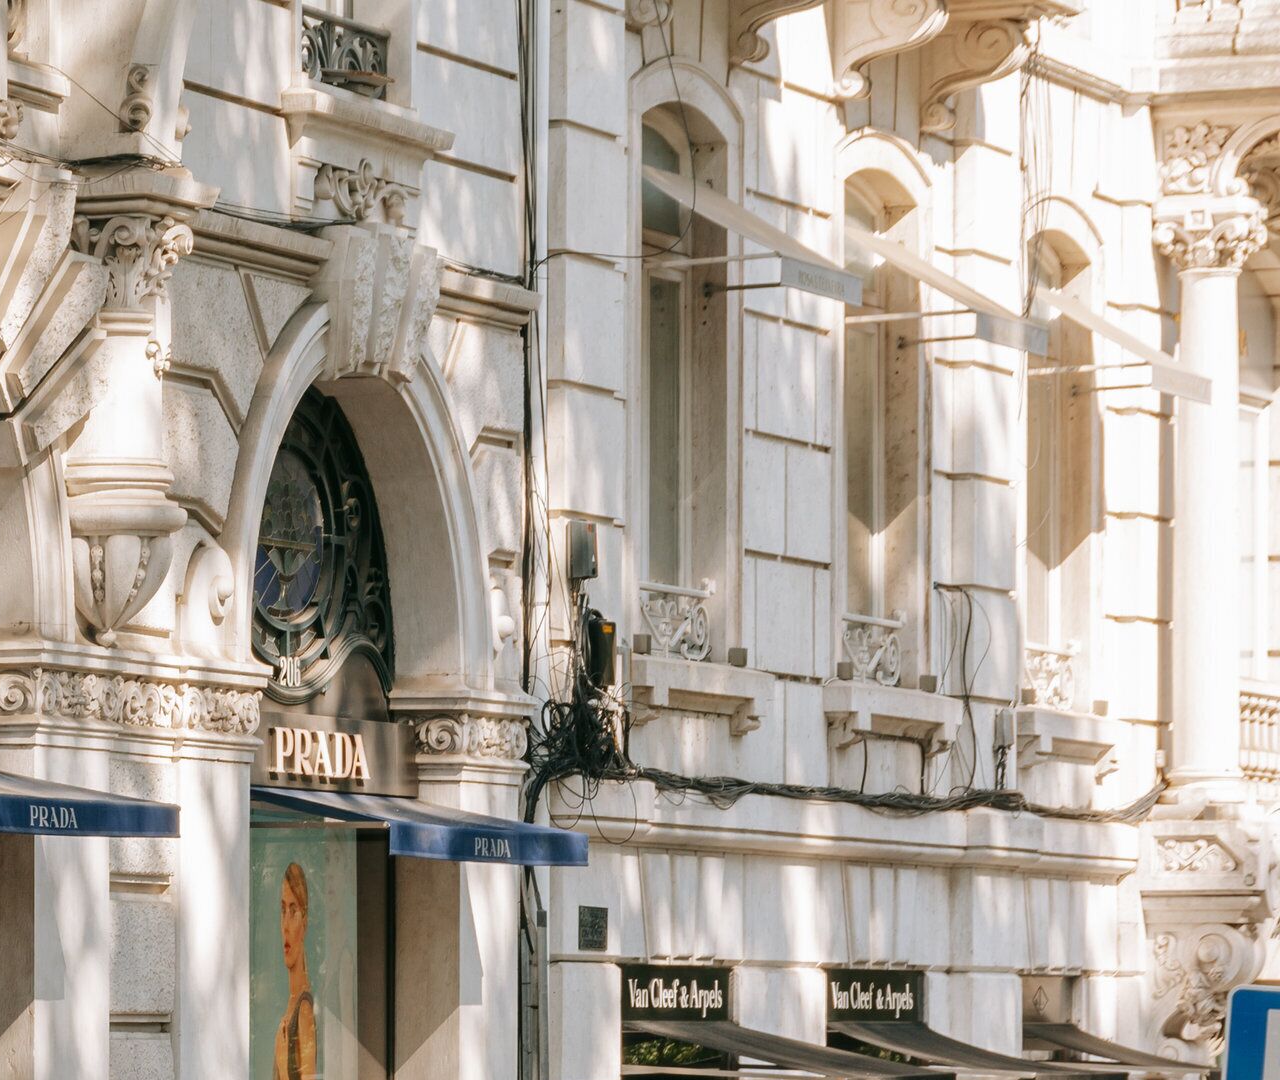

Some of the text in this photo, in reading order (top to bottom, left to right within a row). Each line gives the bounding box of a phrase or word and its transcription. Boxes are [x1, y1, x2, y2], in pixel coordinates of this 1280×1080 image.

[279, 657, 302, 688] 206
[273, 726, 372, 781] PRADA
[28, 804, 79, 830] PRADA
[473, 836, 512, 860] PRADA
[628, 978, 723, 1018] Van Cleef & Arpels
[831, 981, 914, 1019] Van Cleef & Arpels
